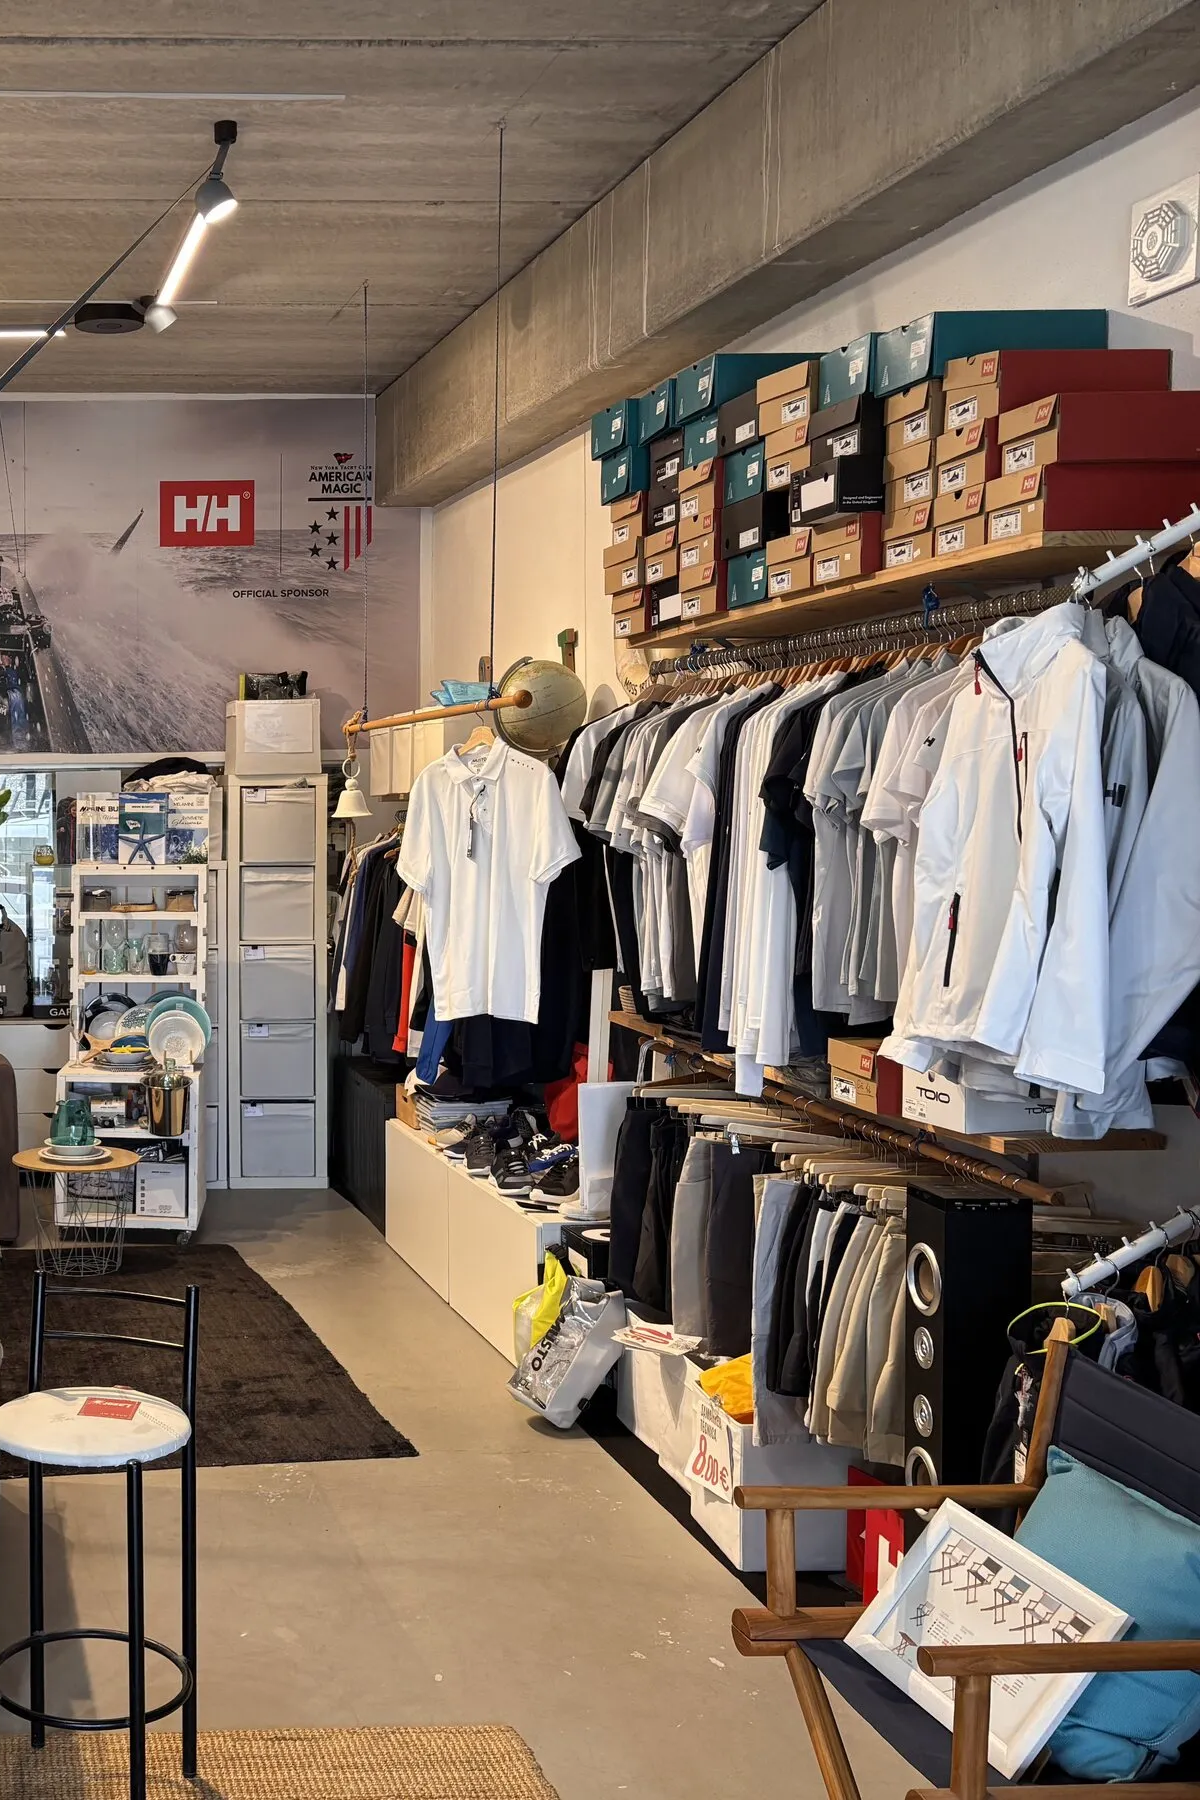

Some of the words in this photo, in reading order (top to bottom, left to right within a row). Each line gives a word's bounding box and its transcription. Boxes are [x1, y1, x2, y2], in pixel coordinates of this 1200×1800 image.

[308, 471, 372, 482] AMERICAN
[321, 483, 362, 494] MAGIC
[173, 495, 241, 533] HH
[232, 589, 278, 598] OFFICIAL
[280, 588, 329, 598] SPONSOR
[915, 1086, 951, 1104] TOIO
[531, 1308, 566, 1371] MUSTO
